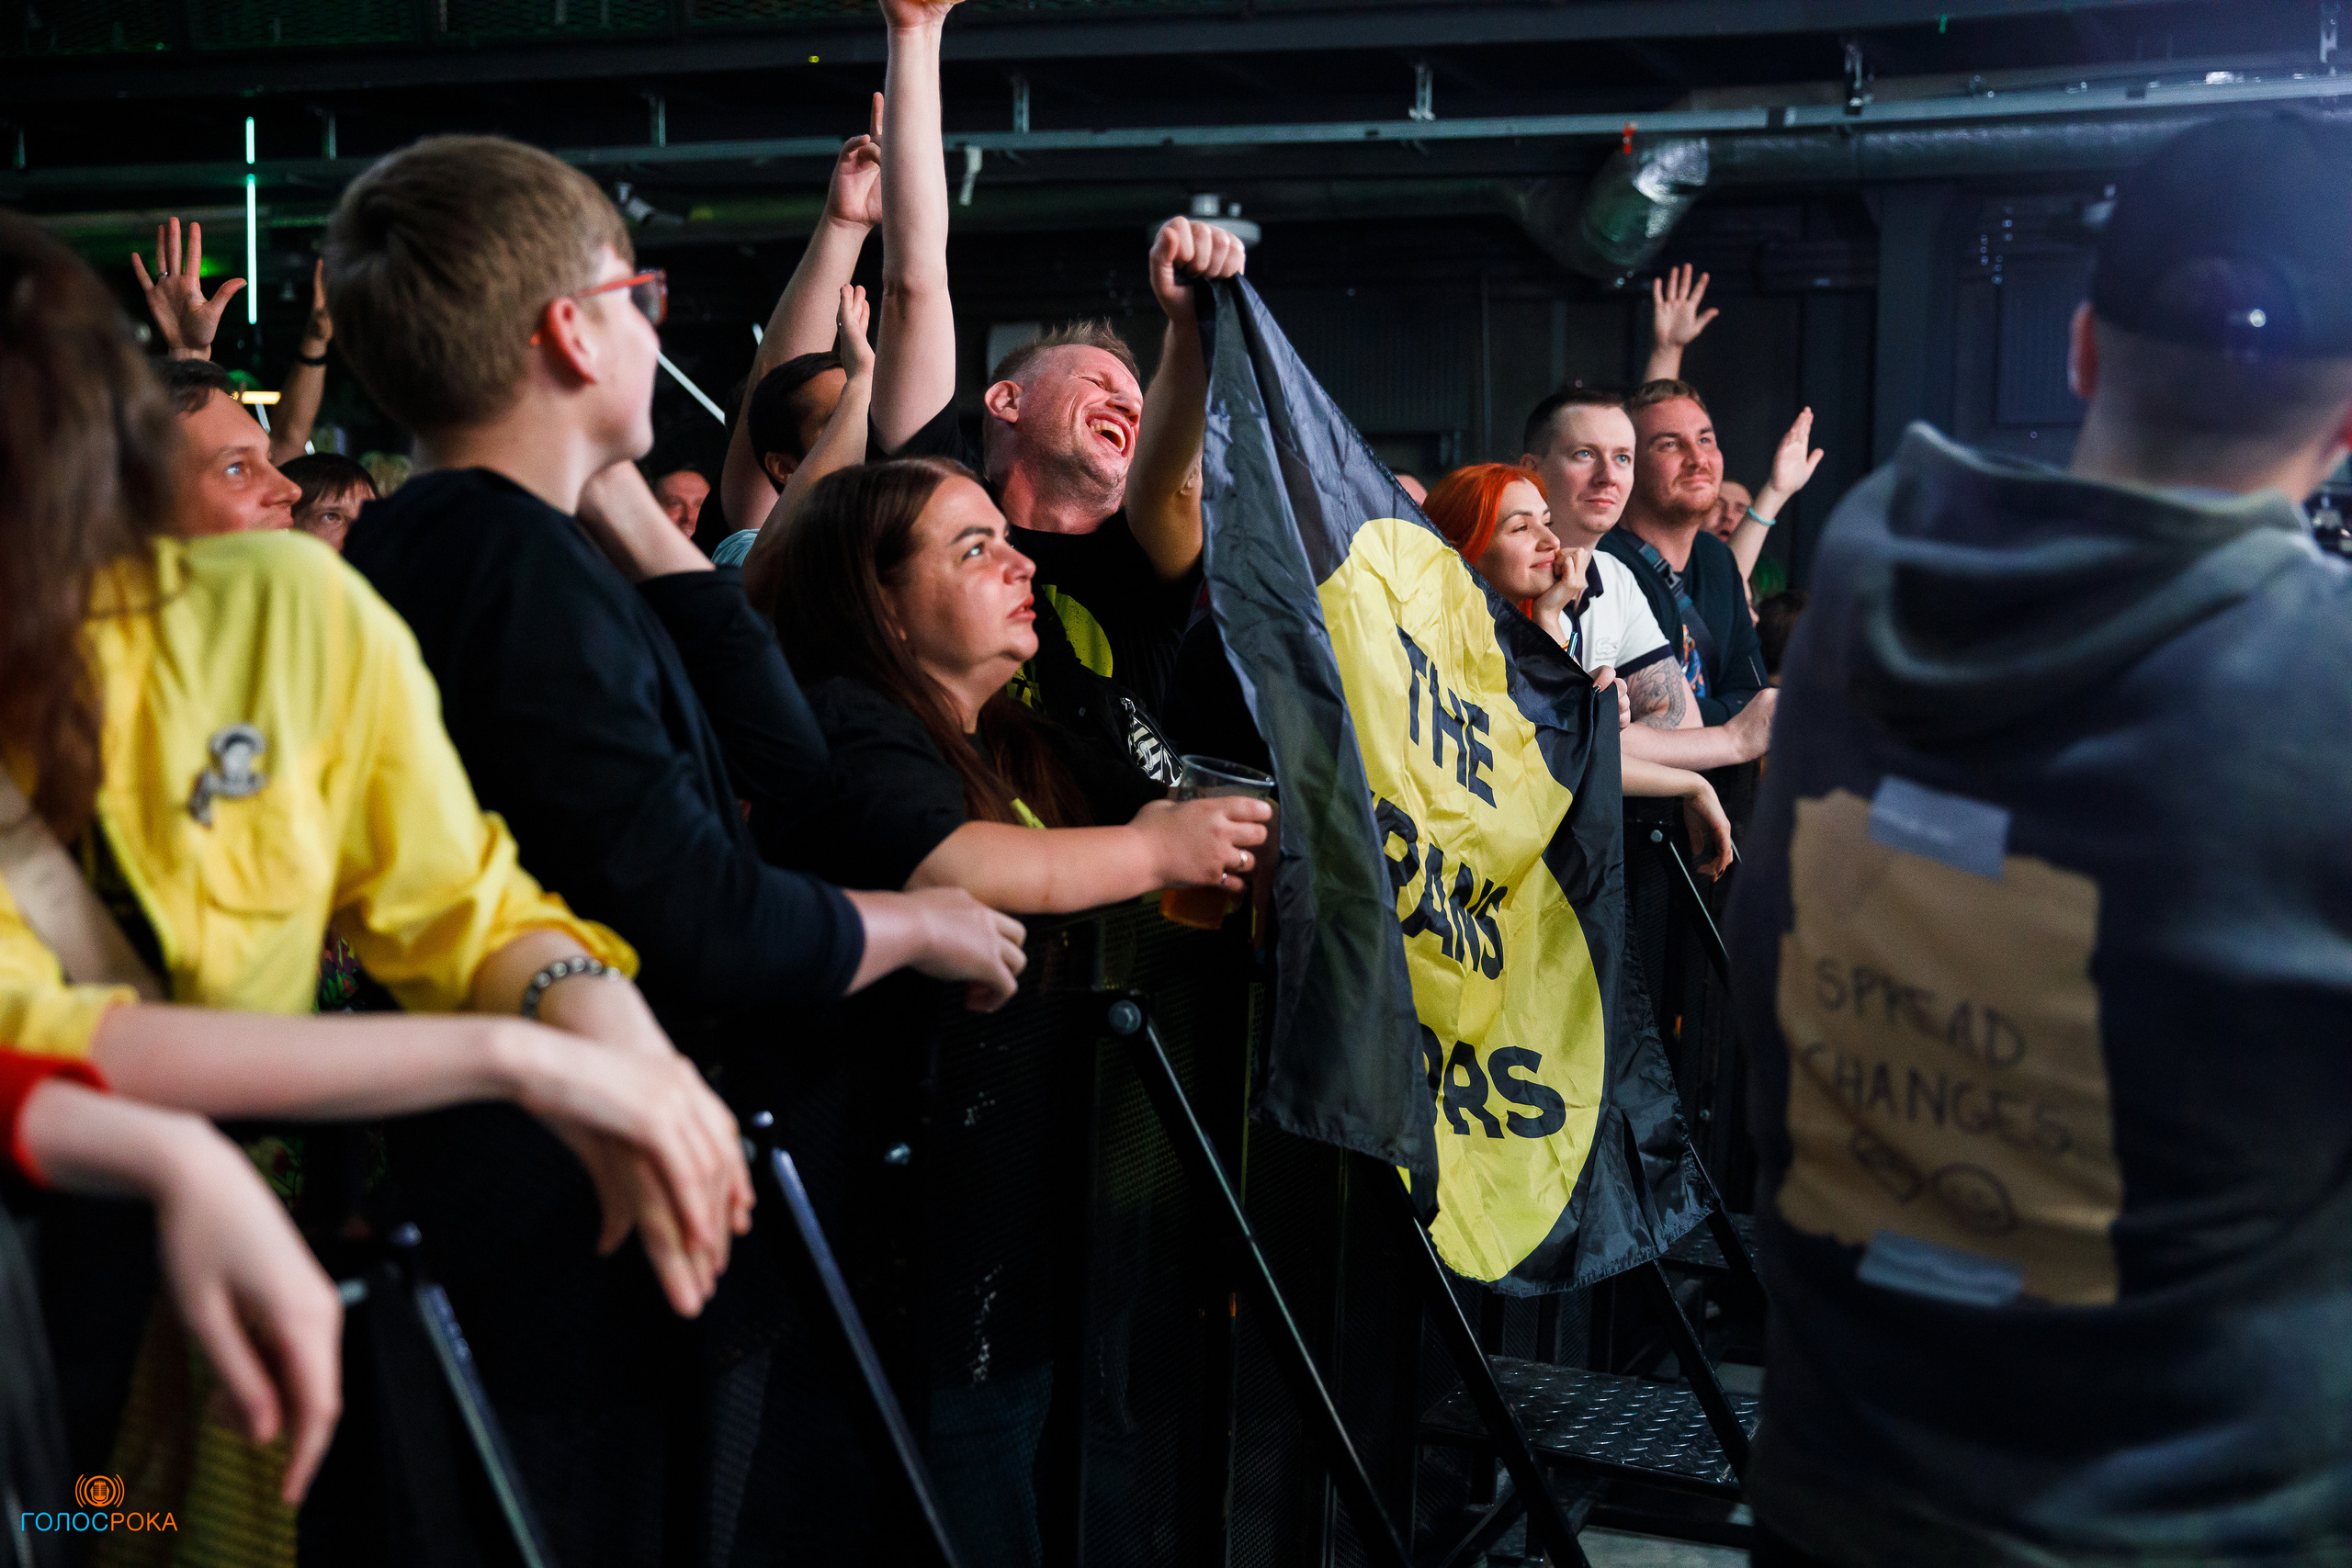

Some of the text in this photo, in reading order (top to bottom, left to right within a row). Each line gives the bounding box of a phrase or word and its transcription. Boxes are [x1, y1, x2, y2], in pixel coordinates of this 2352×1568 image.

[1396, 623, 1498, 809] THE
[1815, 957, 2027, 1069] SPREAD
[1798, 1042, 2074, 1157] CHANGES
